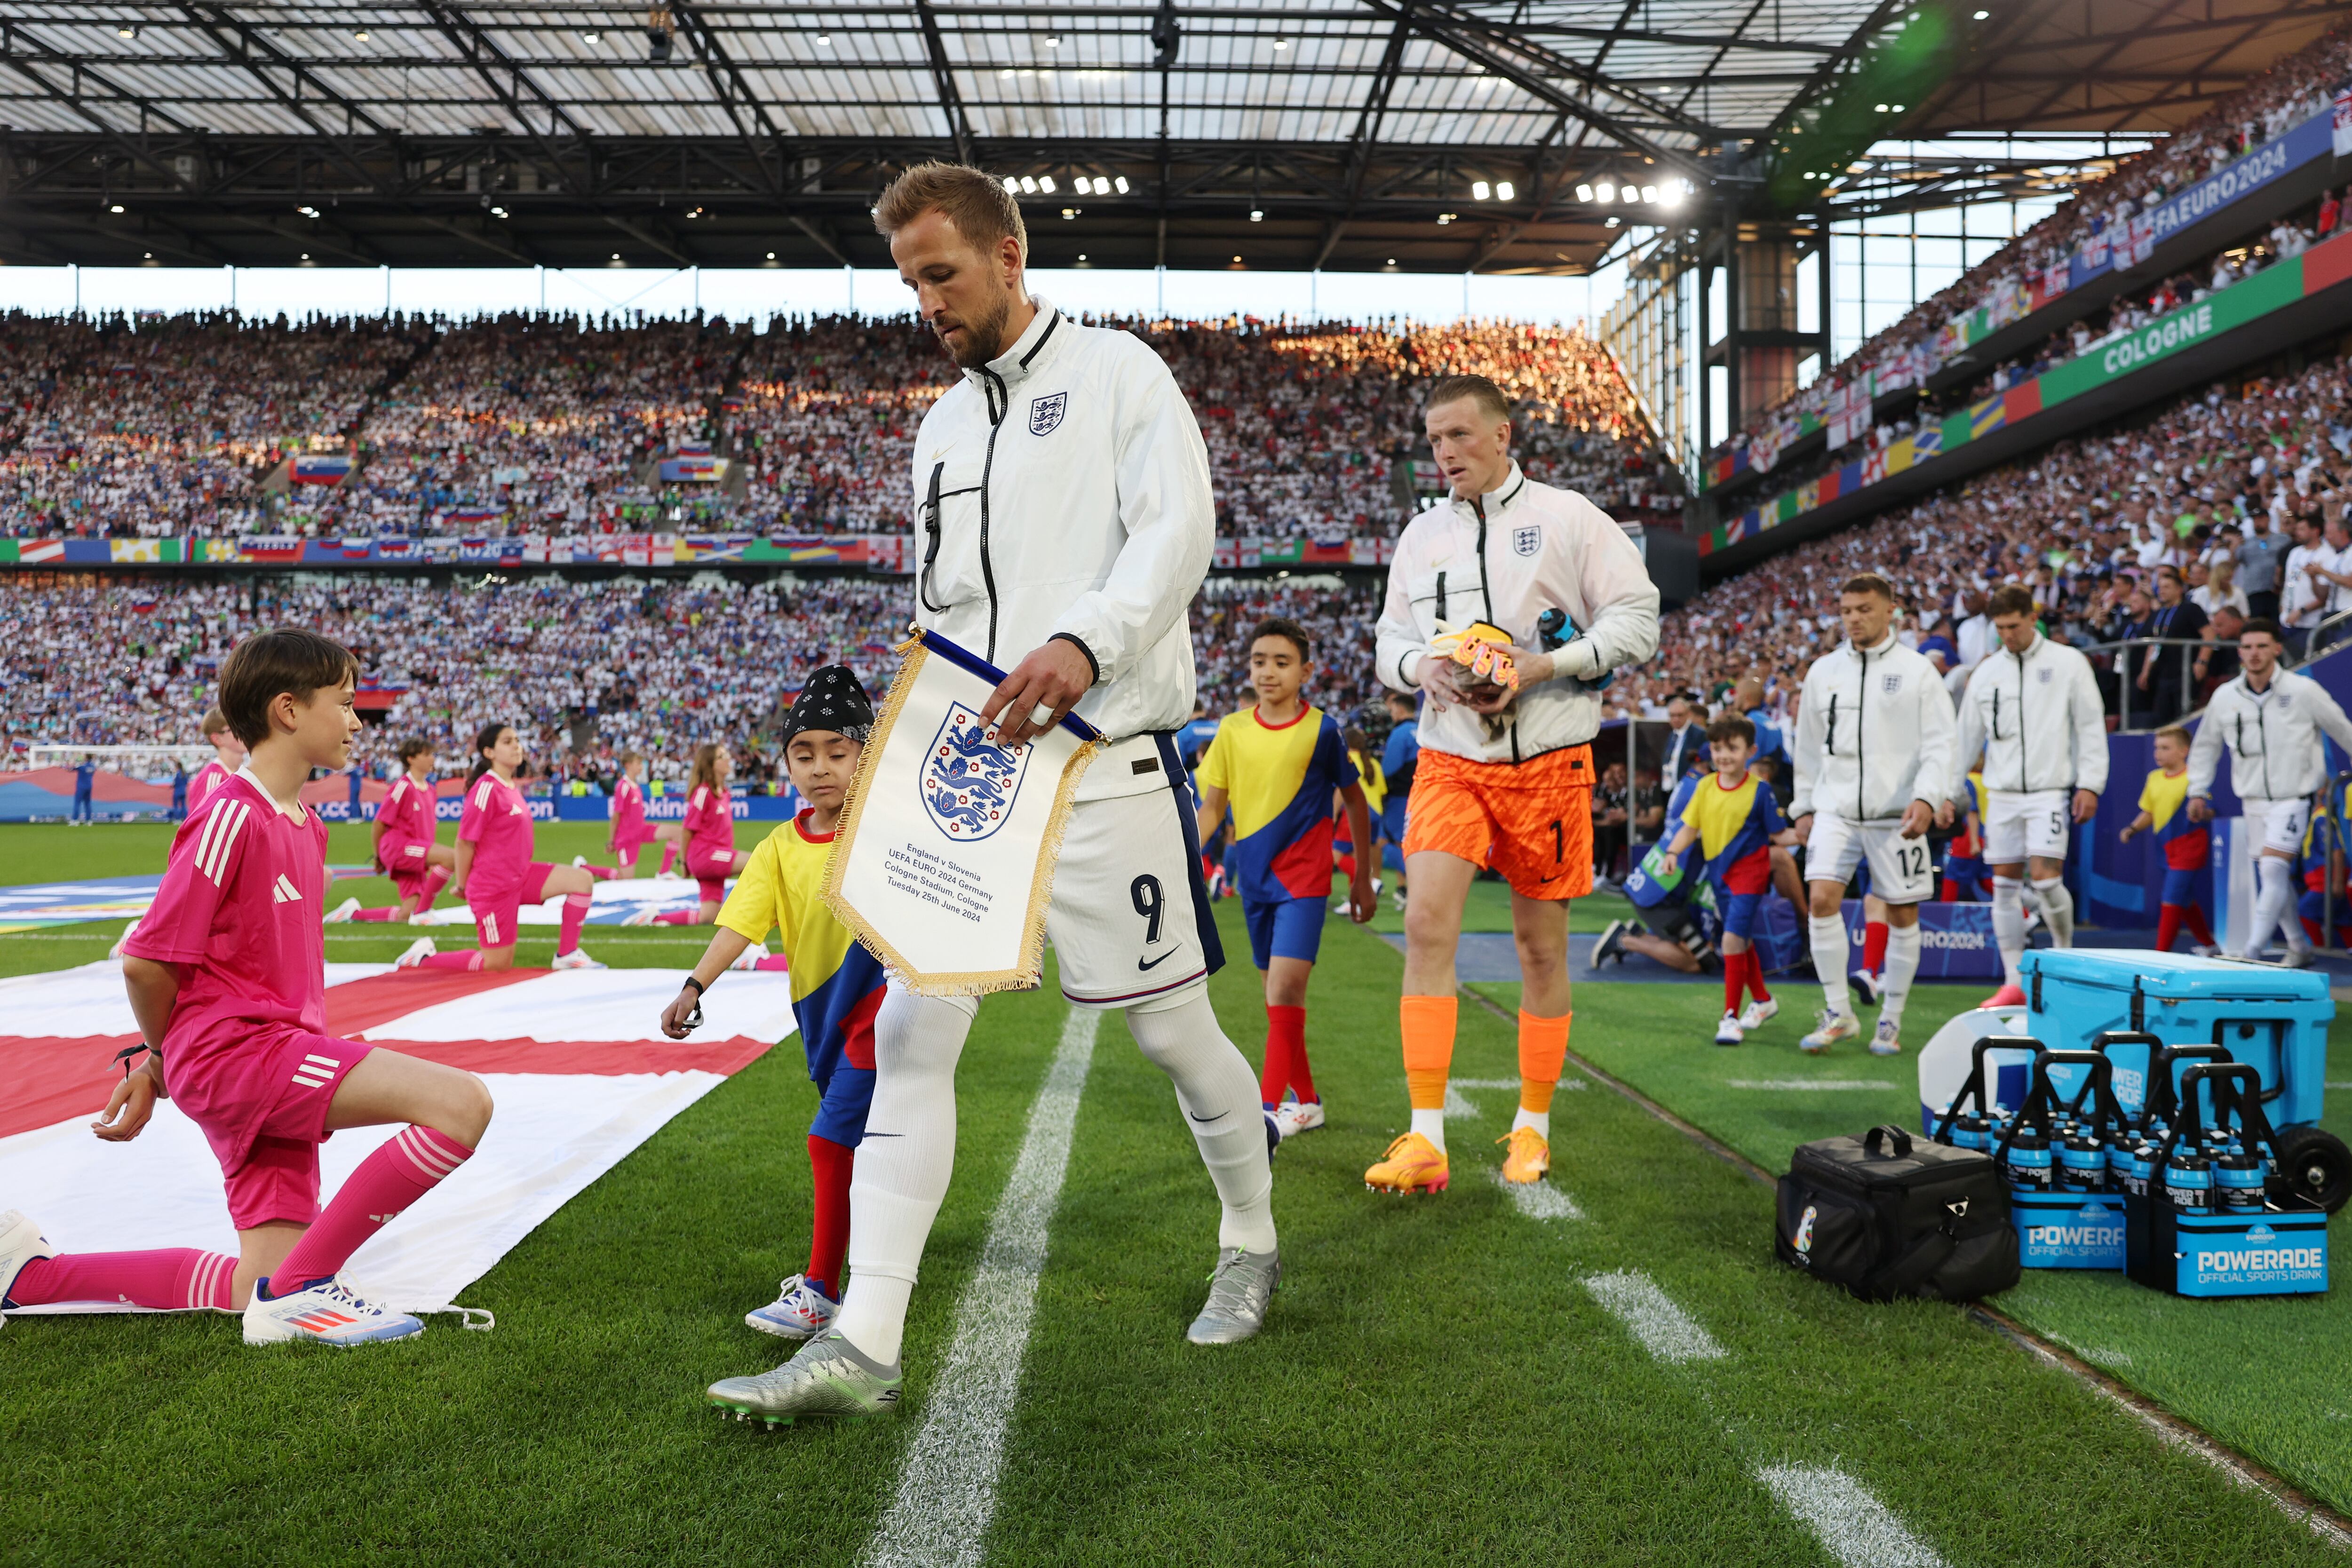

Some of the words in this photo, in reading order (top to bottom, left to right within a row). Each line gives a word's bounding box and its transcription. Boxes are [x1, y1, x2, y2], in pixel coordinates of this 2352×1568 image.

[2104, 304, 2212, 373] COLOGNE
[2051, 812, 2061, 835] 5
[2287, 814, 2297, 834] 4
[1550, 820, 1562, 863] 1
[889, 848, 911, 864] UEFA
[913, 859, 936, 875] EURO
[938, 870, 956, 884] 2024
[959, 880, 993, 902] Germany
[907, 843, 939, 863] England
[948, 861, 981, 882] Slovenia
[1897, 847, 1925, 877] 12
[884, 861, 918, 881] Cologne
[920, 876, 954, 899] Stadium,
[957, 893, 989, 912] Cologne
[888, 876, 920, 897] Tuesday
[922, 891, 939, 905] 25th
[941, 900, 960, 914] June
[962, 909, 980, 923] 2024
[1130, 874, 1165, 945] 9
[1922, 931, 1985, 950] RO2024
[2028, 1246, 2076, 1256] OFFICIAL
[2078, 1247, 2122, 1258] SPORTS
[2198, 1248, 2322, 1272] POWERADE
[2198, 1272, 2244, 1284] OFFICIAL
[2246, 1270, 2288, 1282] SPORTS
[2290, 1269, 2322, 1281] DRINK
